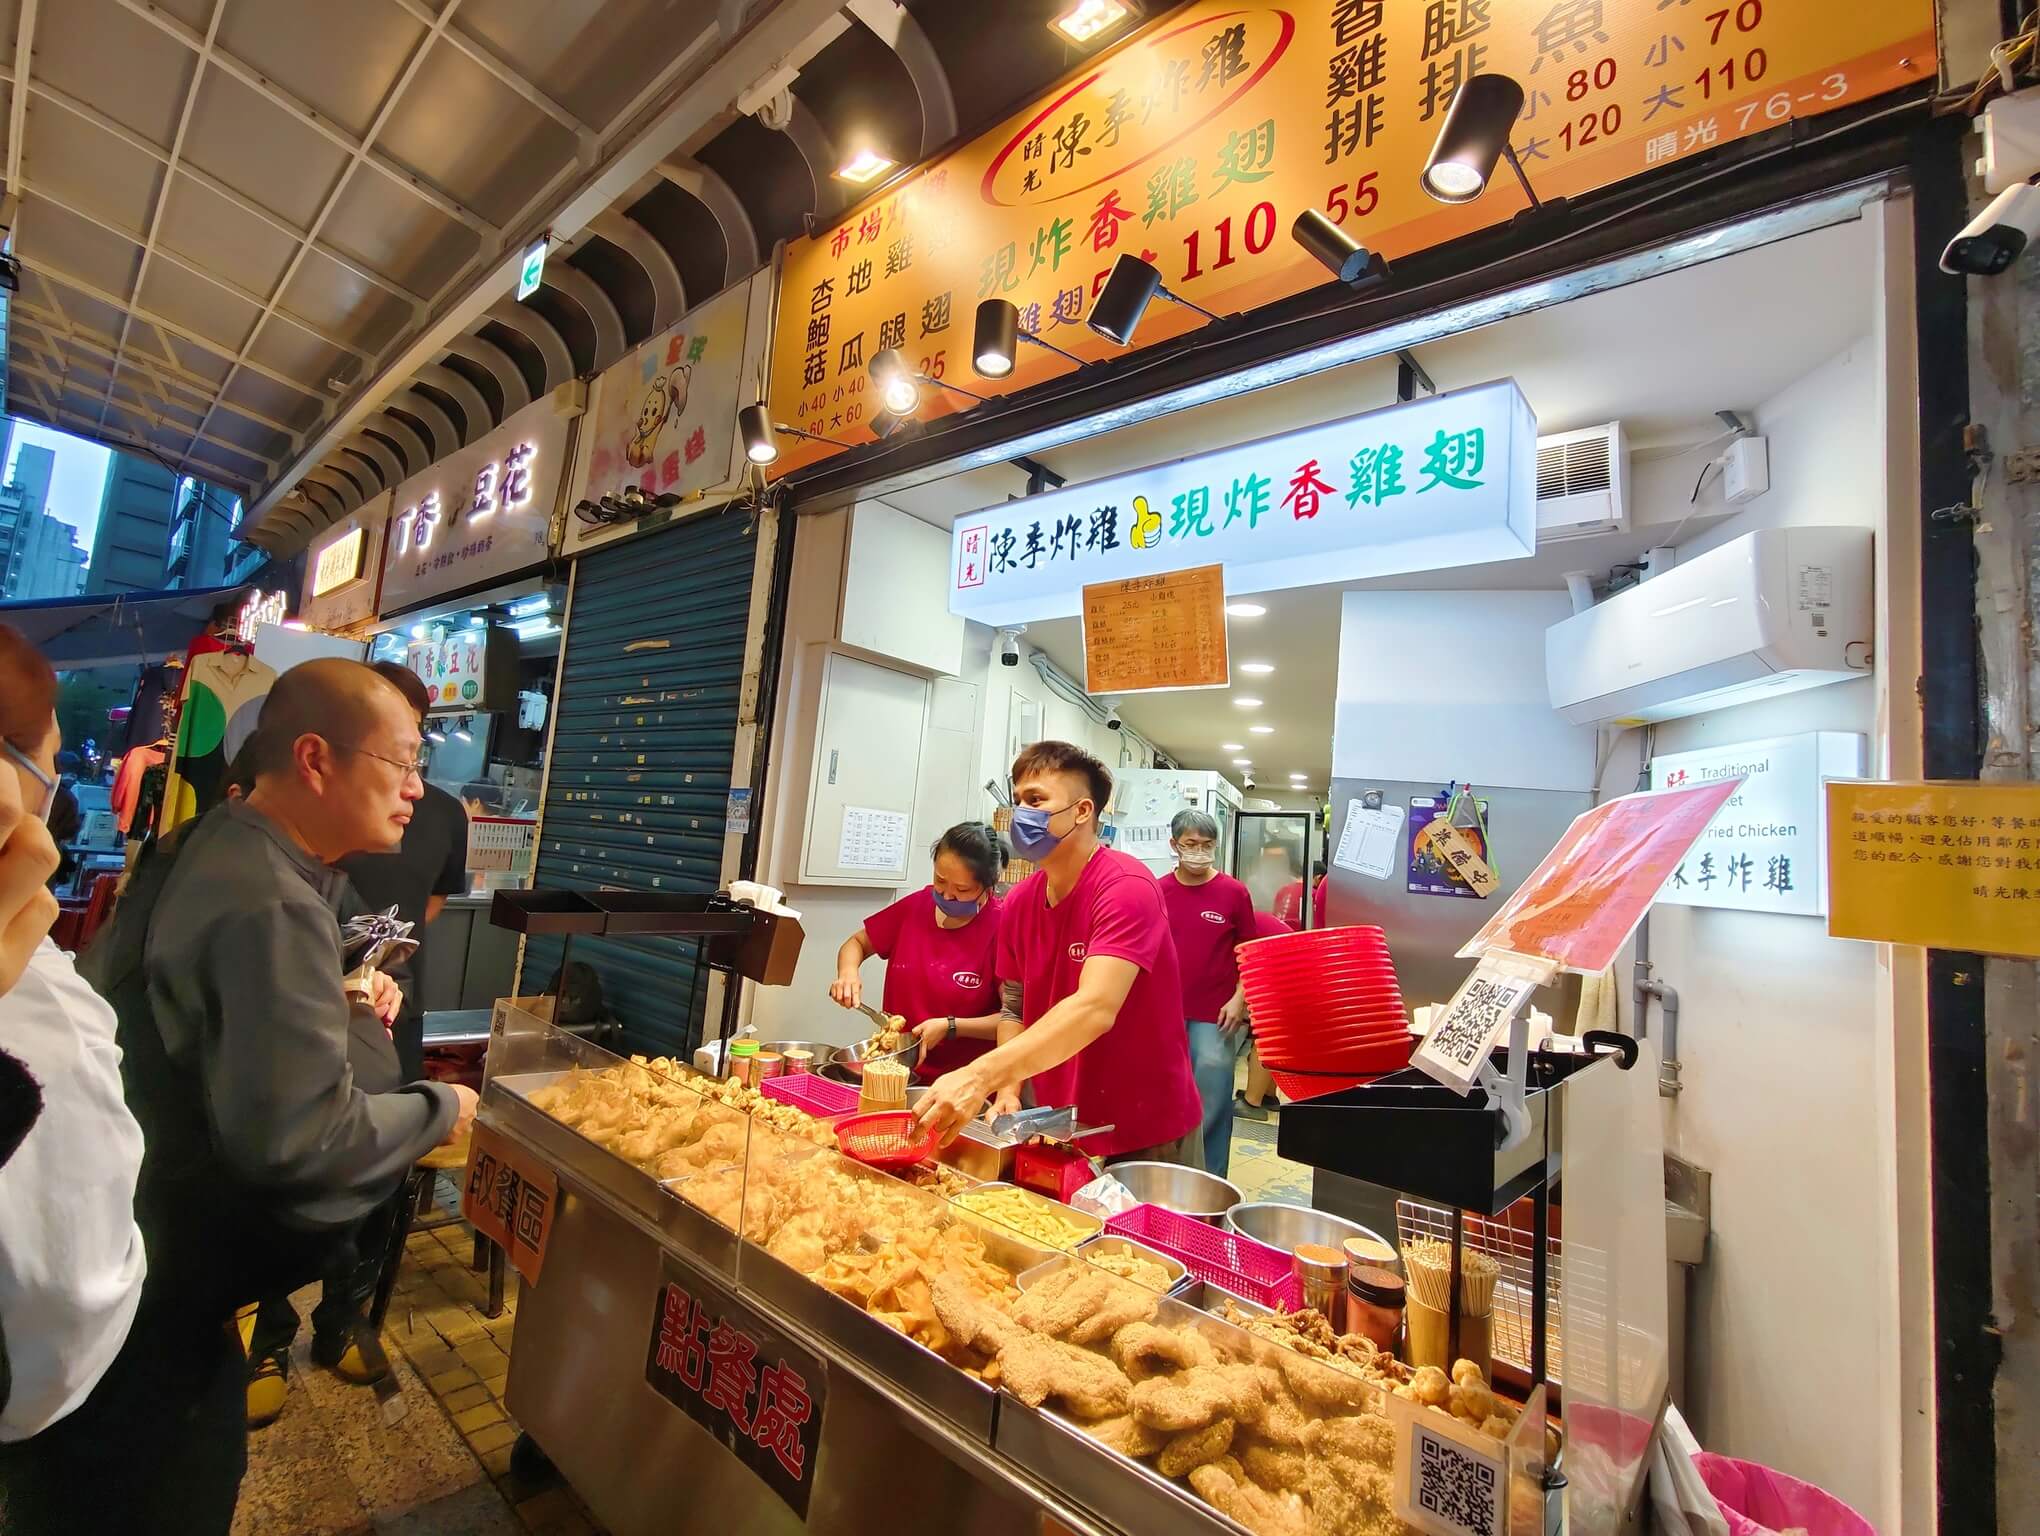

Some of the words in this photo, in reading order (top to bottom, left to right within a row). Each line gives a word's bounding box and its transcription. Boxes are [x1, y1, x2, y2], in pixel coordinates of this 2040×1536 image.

[1642, 34, 1685, 68] 小
[1704, 0, 1762, 46] 70
[1324, 0, 1387, 165] 香雞排
[1519, 89, 1551, 121] 小
[1566, 57, 1617, 102] 80
[1642, 84, 1685, 121] 大
[1695, 47, 1768, 99] 110
[1514, 136, 1551, 167] 大
[1558, 103, 1622, 152] 120
[1645, 118, 1719, 165] 晴光
[1732, 72, 1849, 132] 76-3
[1019, 131, 1047, 197] 晴光
[1325, 171, 1380, 227] 55
[976, 118, 1276, 298] 現炸香雞翅
[1180, 201, 1277, 283] 110
[802, 277, 835, 390] 杏鮑菇
[837, 258, 873, 376] 地瓜
[811, 392, 826, 412] 40
[846, 402, 863, 423] 60
[848, 375, 865, 396] 40
[809, 418, 824, 436] 60
[465, 442, 538, 523] 豆花
[988, 505, 1121, 574] 陳季炸雞
[1168, 426, 1487, 537] 現炸香雞翅
[1700, 758, 1769, 779] Traditional
[1708, 824, 1734, 839] ried
[1738, 823, 1797, 839] Chicken
[468, 1145, 550, 1256] 取餐區
[655, 1280, 813, 1481] 點餐處
